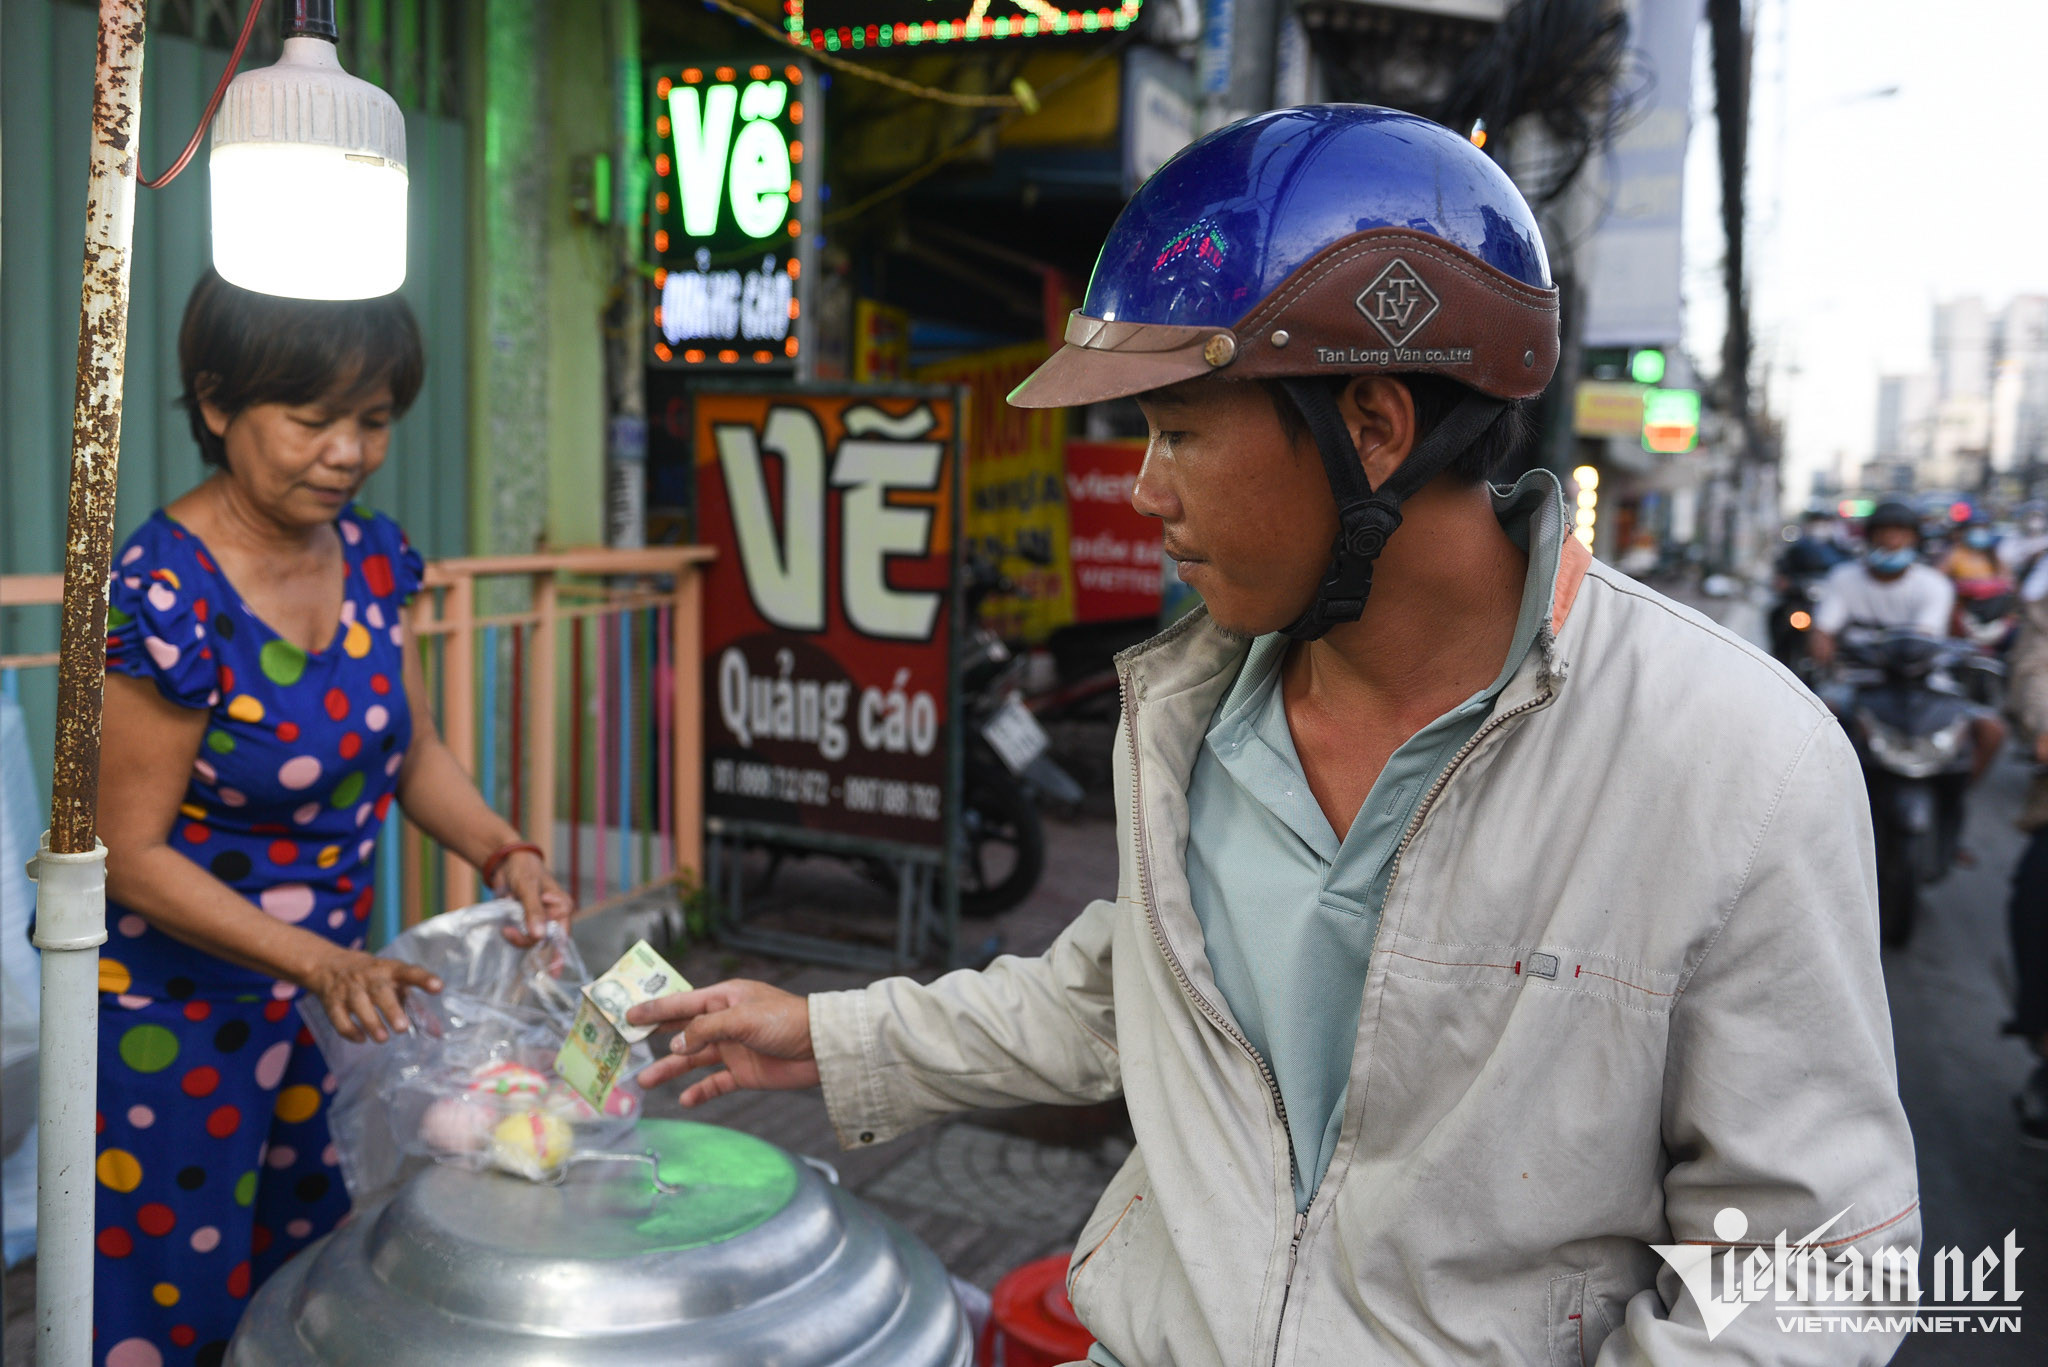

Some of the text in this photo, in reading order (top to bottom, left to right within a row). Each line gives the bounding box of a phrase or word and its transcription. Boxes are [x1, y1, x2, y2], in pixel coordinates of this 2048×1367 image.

[668, 81, 792, 239] Vẽ
[1317, 349, 1345, 363] Tan
[1350, 349, 1389, 366] Long
[1393, 348, 1421, 362] Van
[713, 404, 944, 641] VẼ
[718, 645, 850, 760] Quảng
[858, 668, 938, 757] cáo
